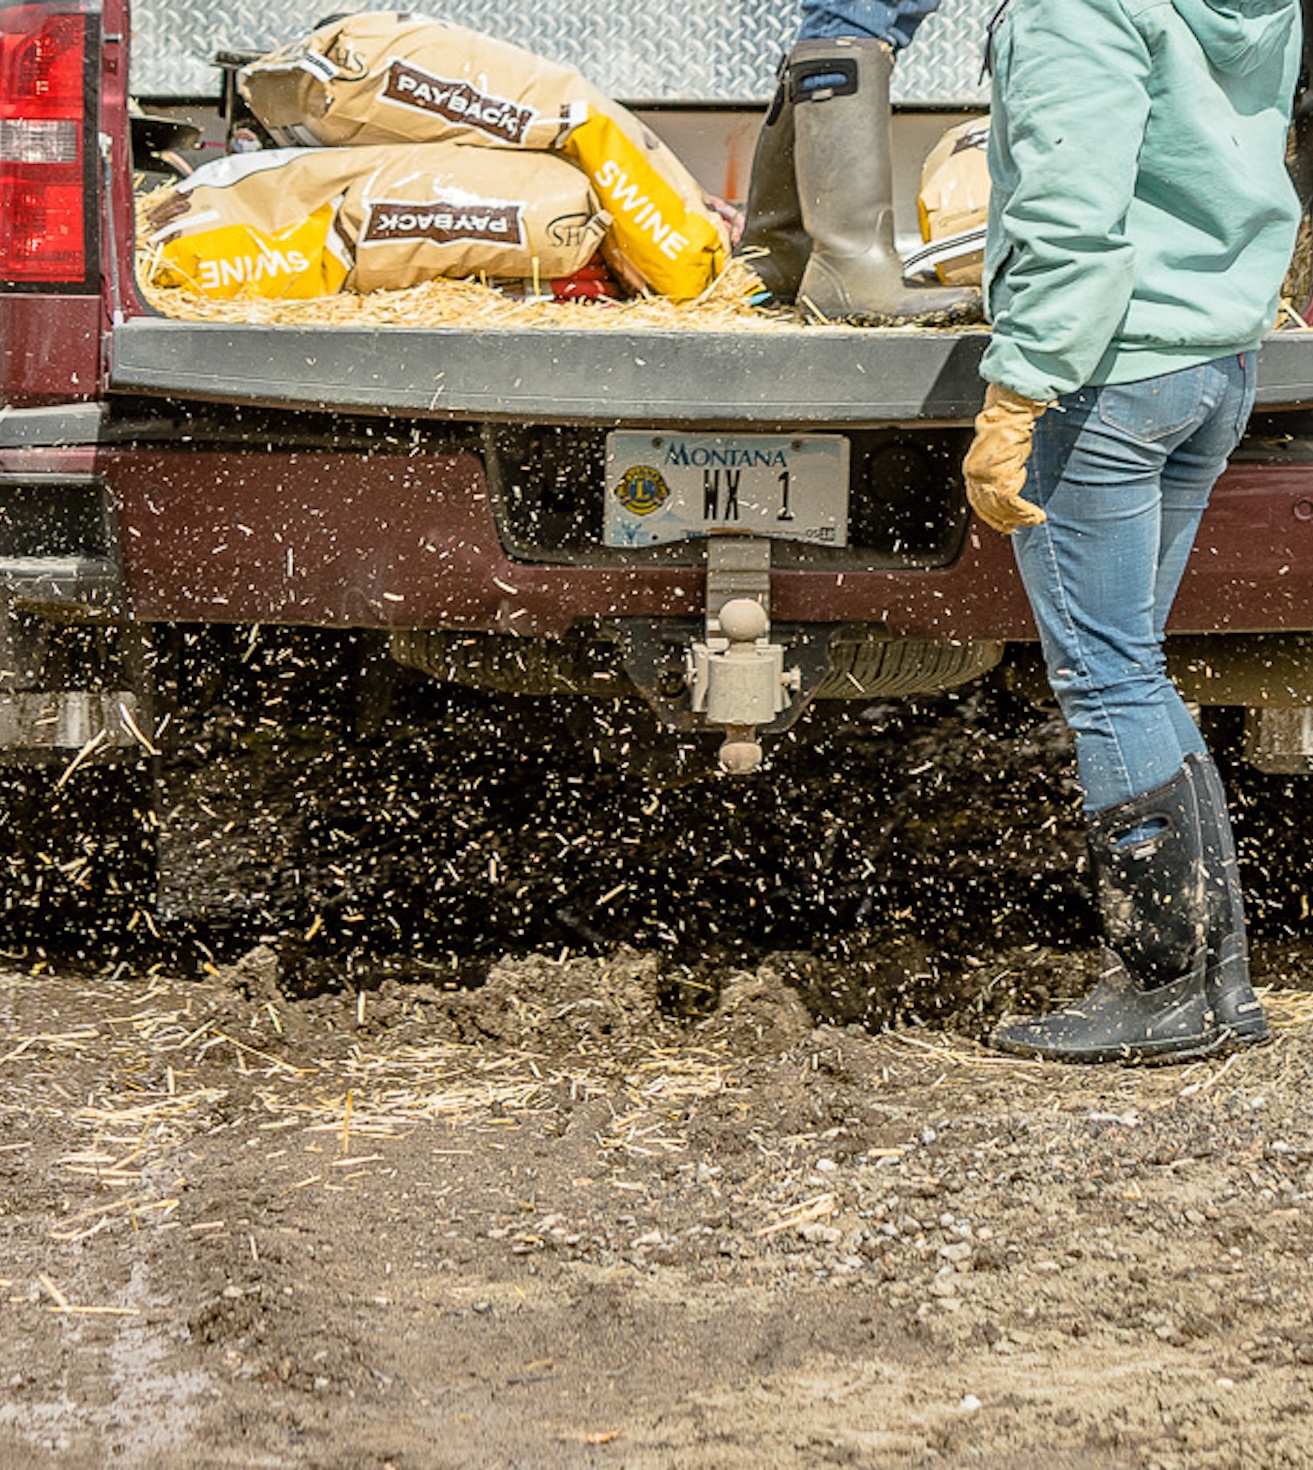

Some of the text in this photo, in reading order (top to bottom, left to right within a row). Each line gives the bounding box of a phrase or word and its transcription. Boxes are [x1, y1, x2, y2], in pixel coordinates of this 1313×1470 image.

[396, 75, 520, 136] PAYBACK
[377, 213, 508, 233] PAYBACK
[595, 160, 690, 261] SWINE
[549, 226, 583, 248] HS
[198, 250, 310, 289] SWINE
[664, 442, 788, 467] MONTANA
[777, 471, 794, 520] 1
